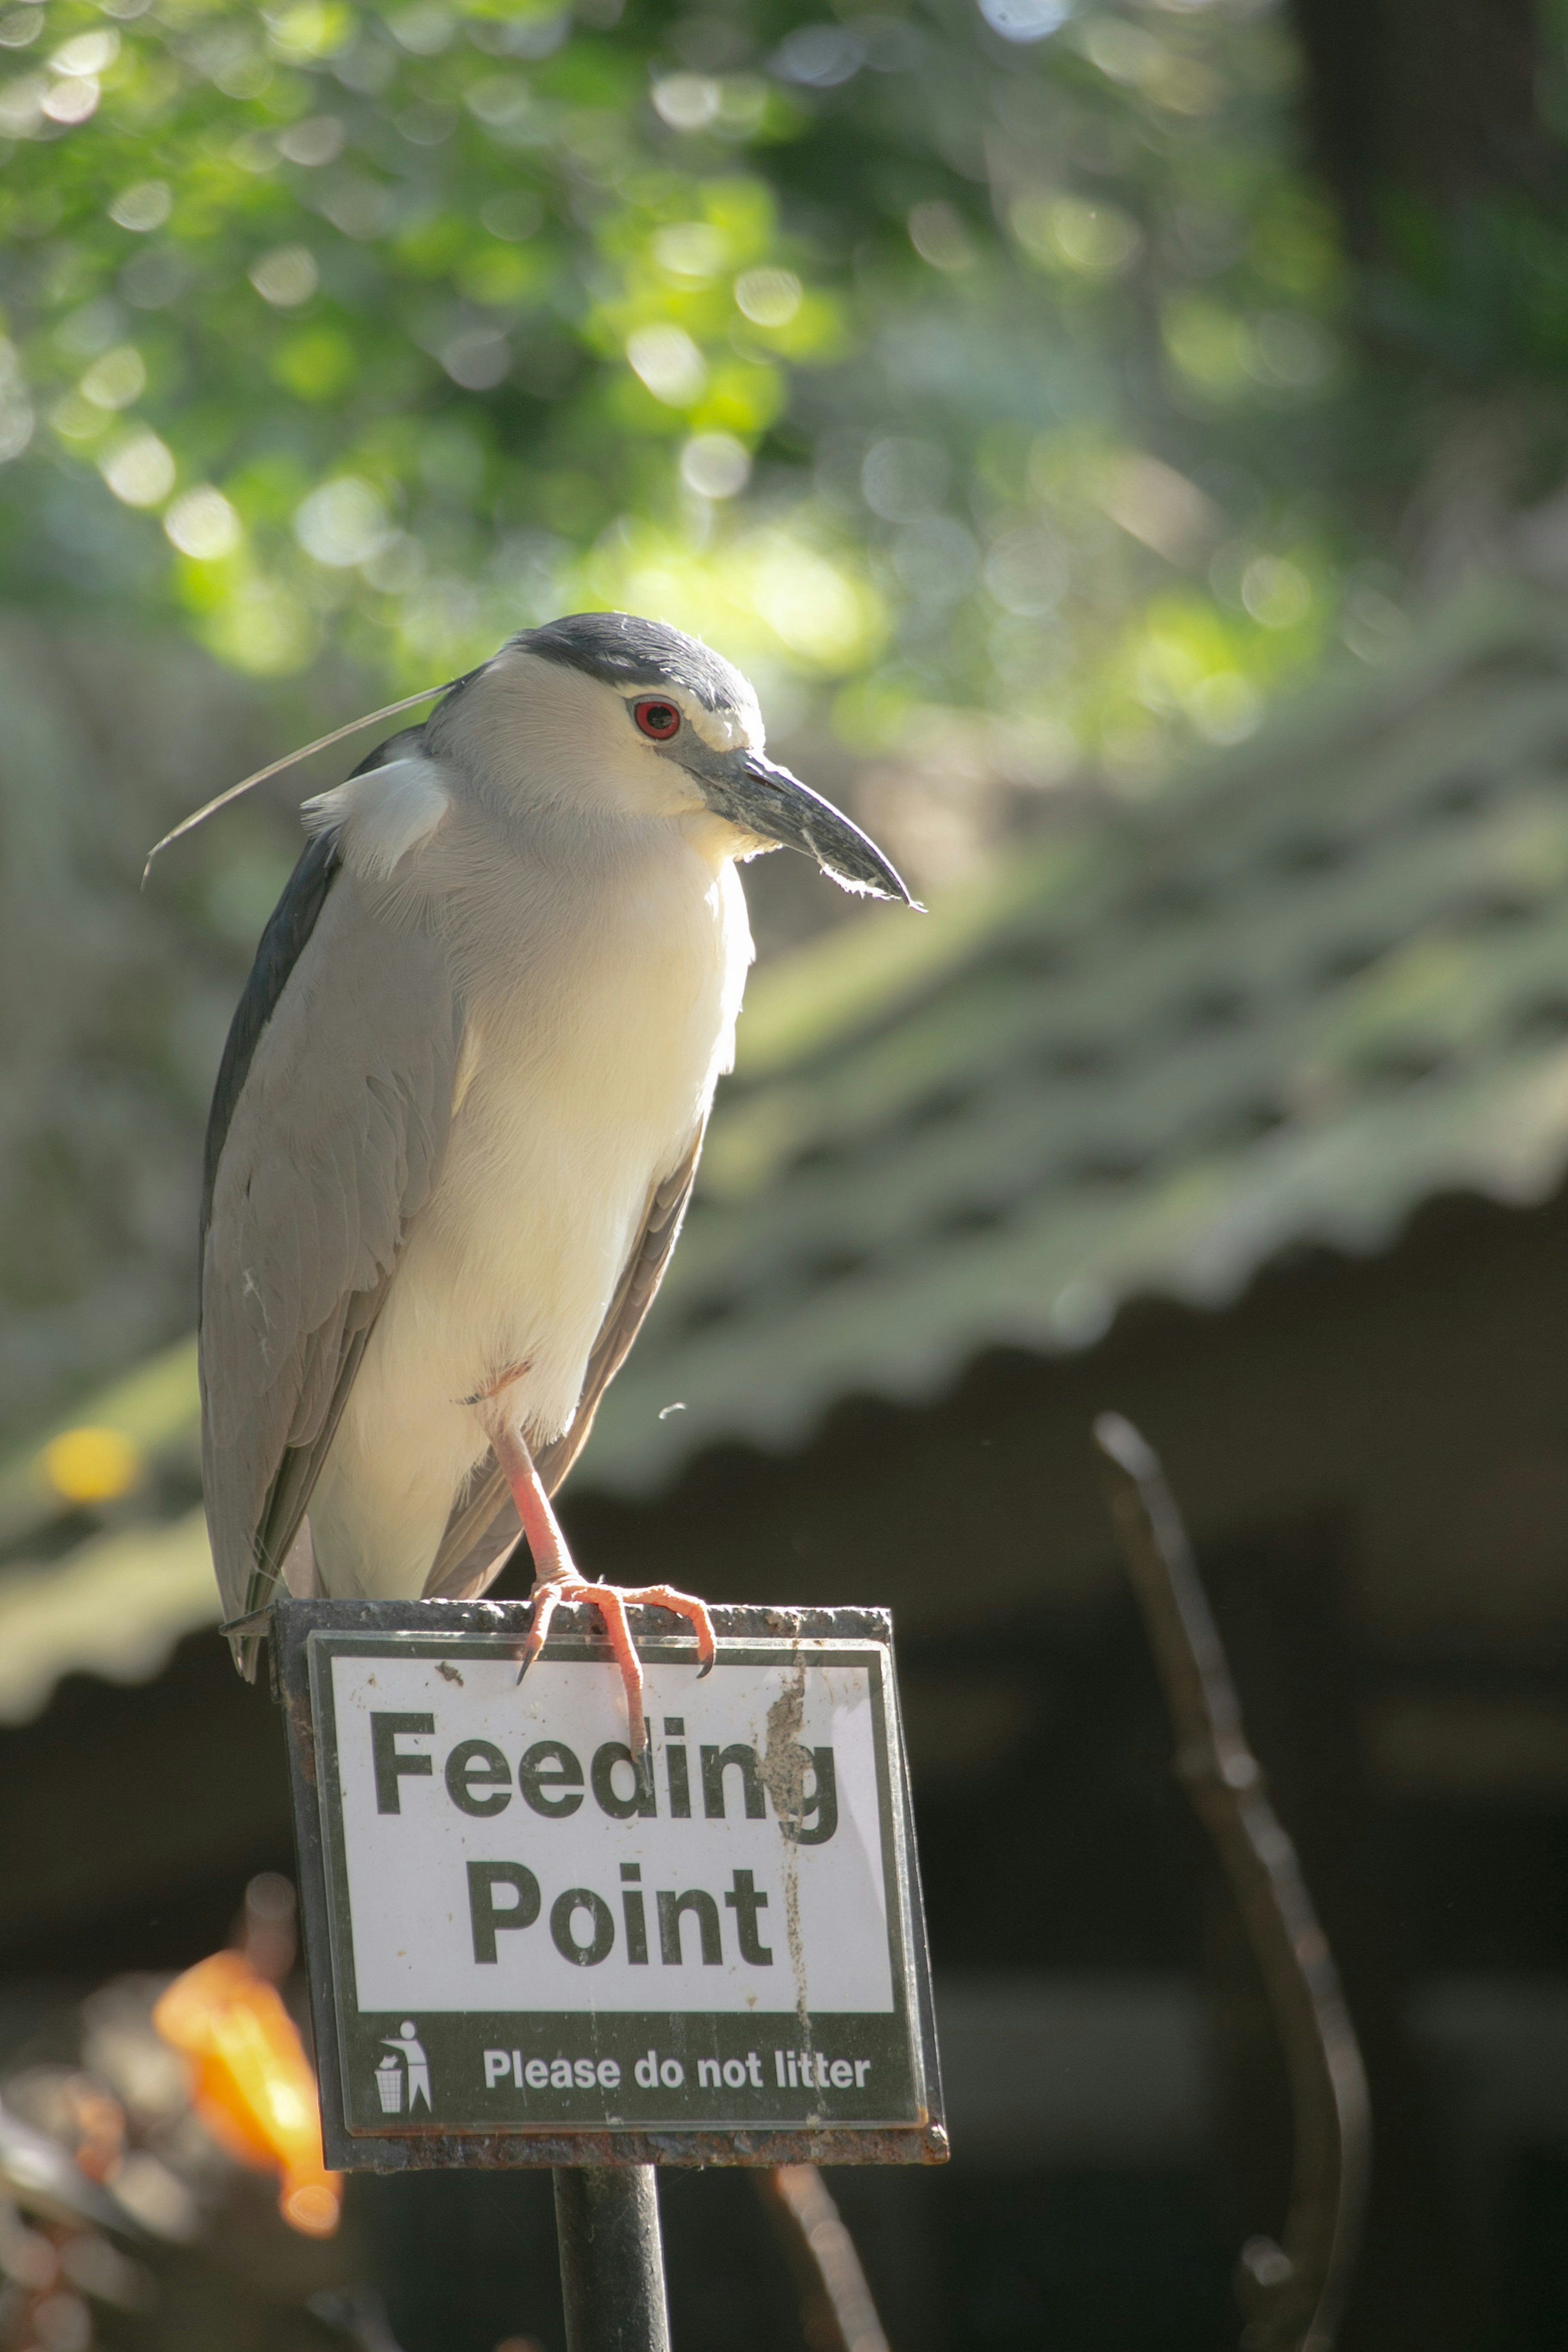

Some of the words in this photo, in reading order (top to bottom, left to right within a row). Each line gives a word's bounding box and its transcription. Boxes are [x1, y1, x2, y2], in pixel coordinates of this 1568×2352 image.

[370, 1711, 839, 1845] Feeding
[466, 1861, 773, 1967] Point
[483, 2050, 620, 2089] Please
[634, 2050, 684, 2089] do
[698, 2052, 763, 2089] not
[775, 2050, 871, 2089] litter
